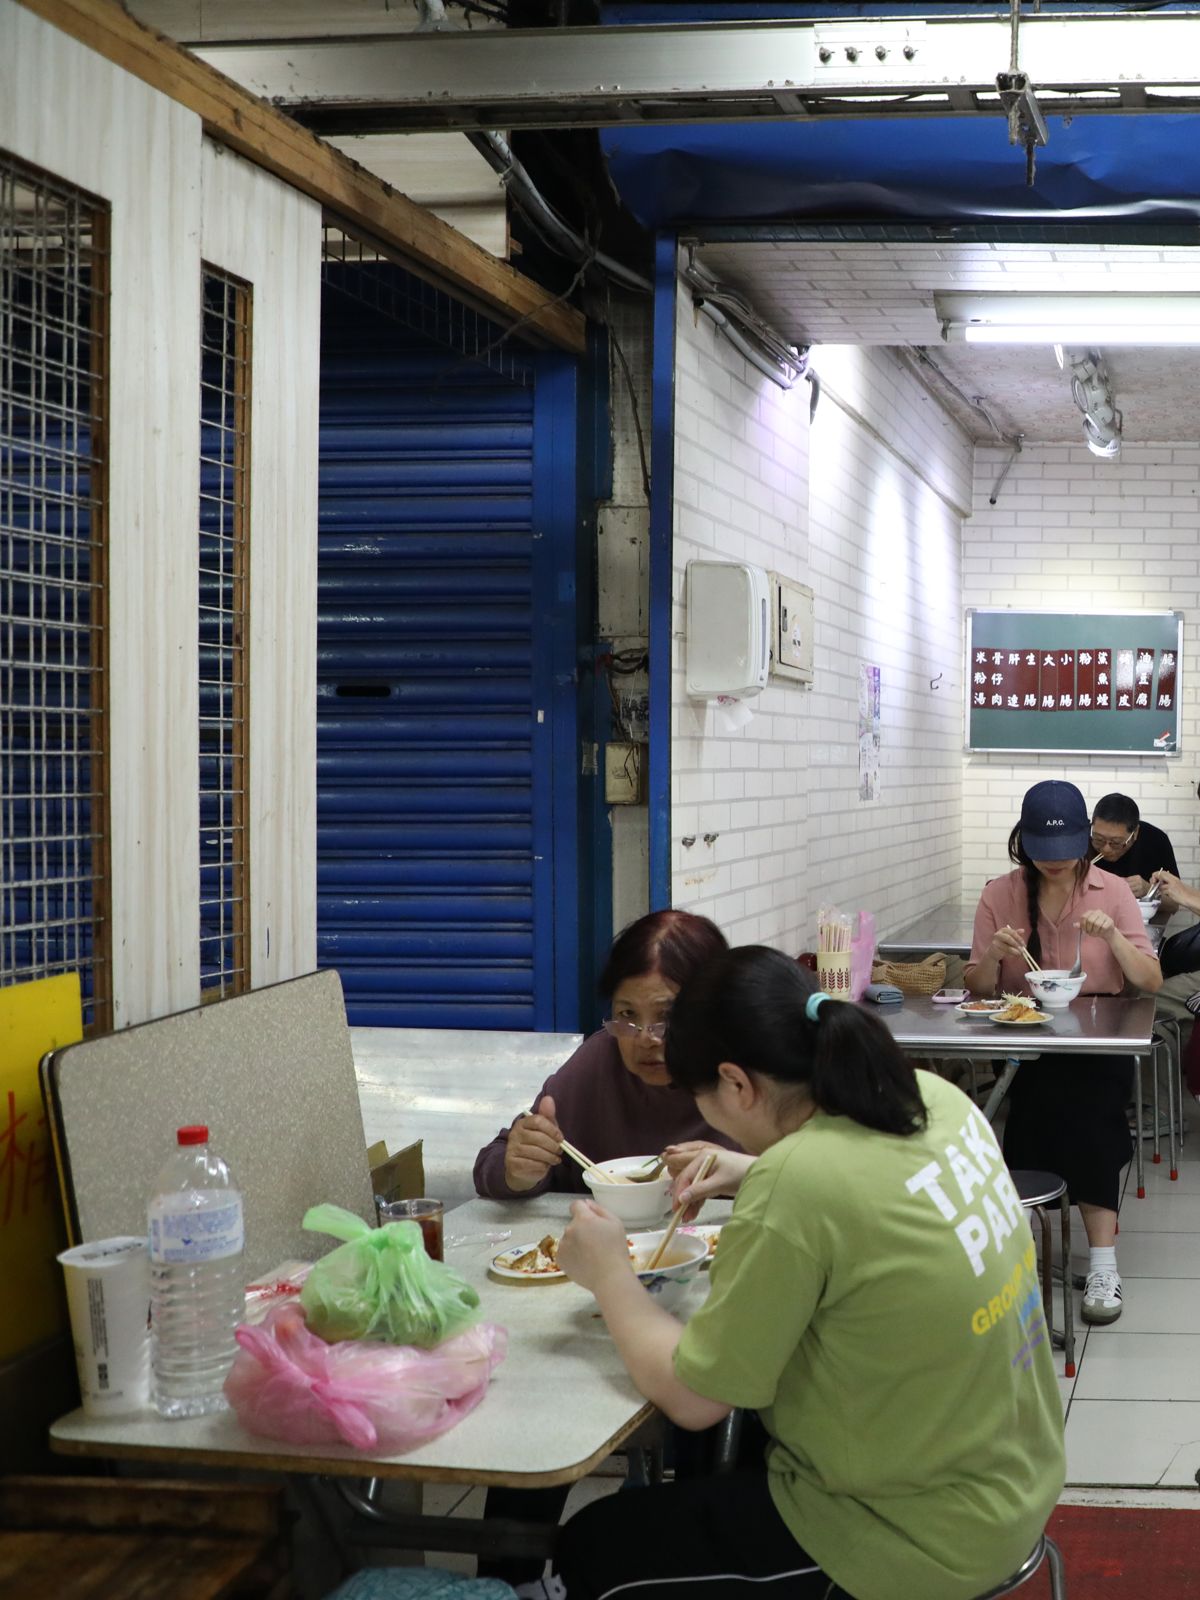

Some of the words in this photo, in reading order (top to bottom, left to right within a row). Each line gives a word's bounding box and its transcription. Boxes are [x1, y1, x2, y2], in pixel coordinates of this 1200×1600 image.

[974, 651, 987, 705] 米粉湯
[991, 652, 1003, 707] 骨仔肉
[1024, 653, 1036, 707] 生腸
[1042, 654, 1055, 708] 大腸
[1060, 653, 1072, 707] 小腸
[1079, 652, 1092, 707] 粉腸
[1135, 652, 1151, 706] 油豆腐
